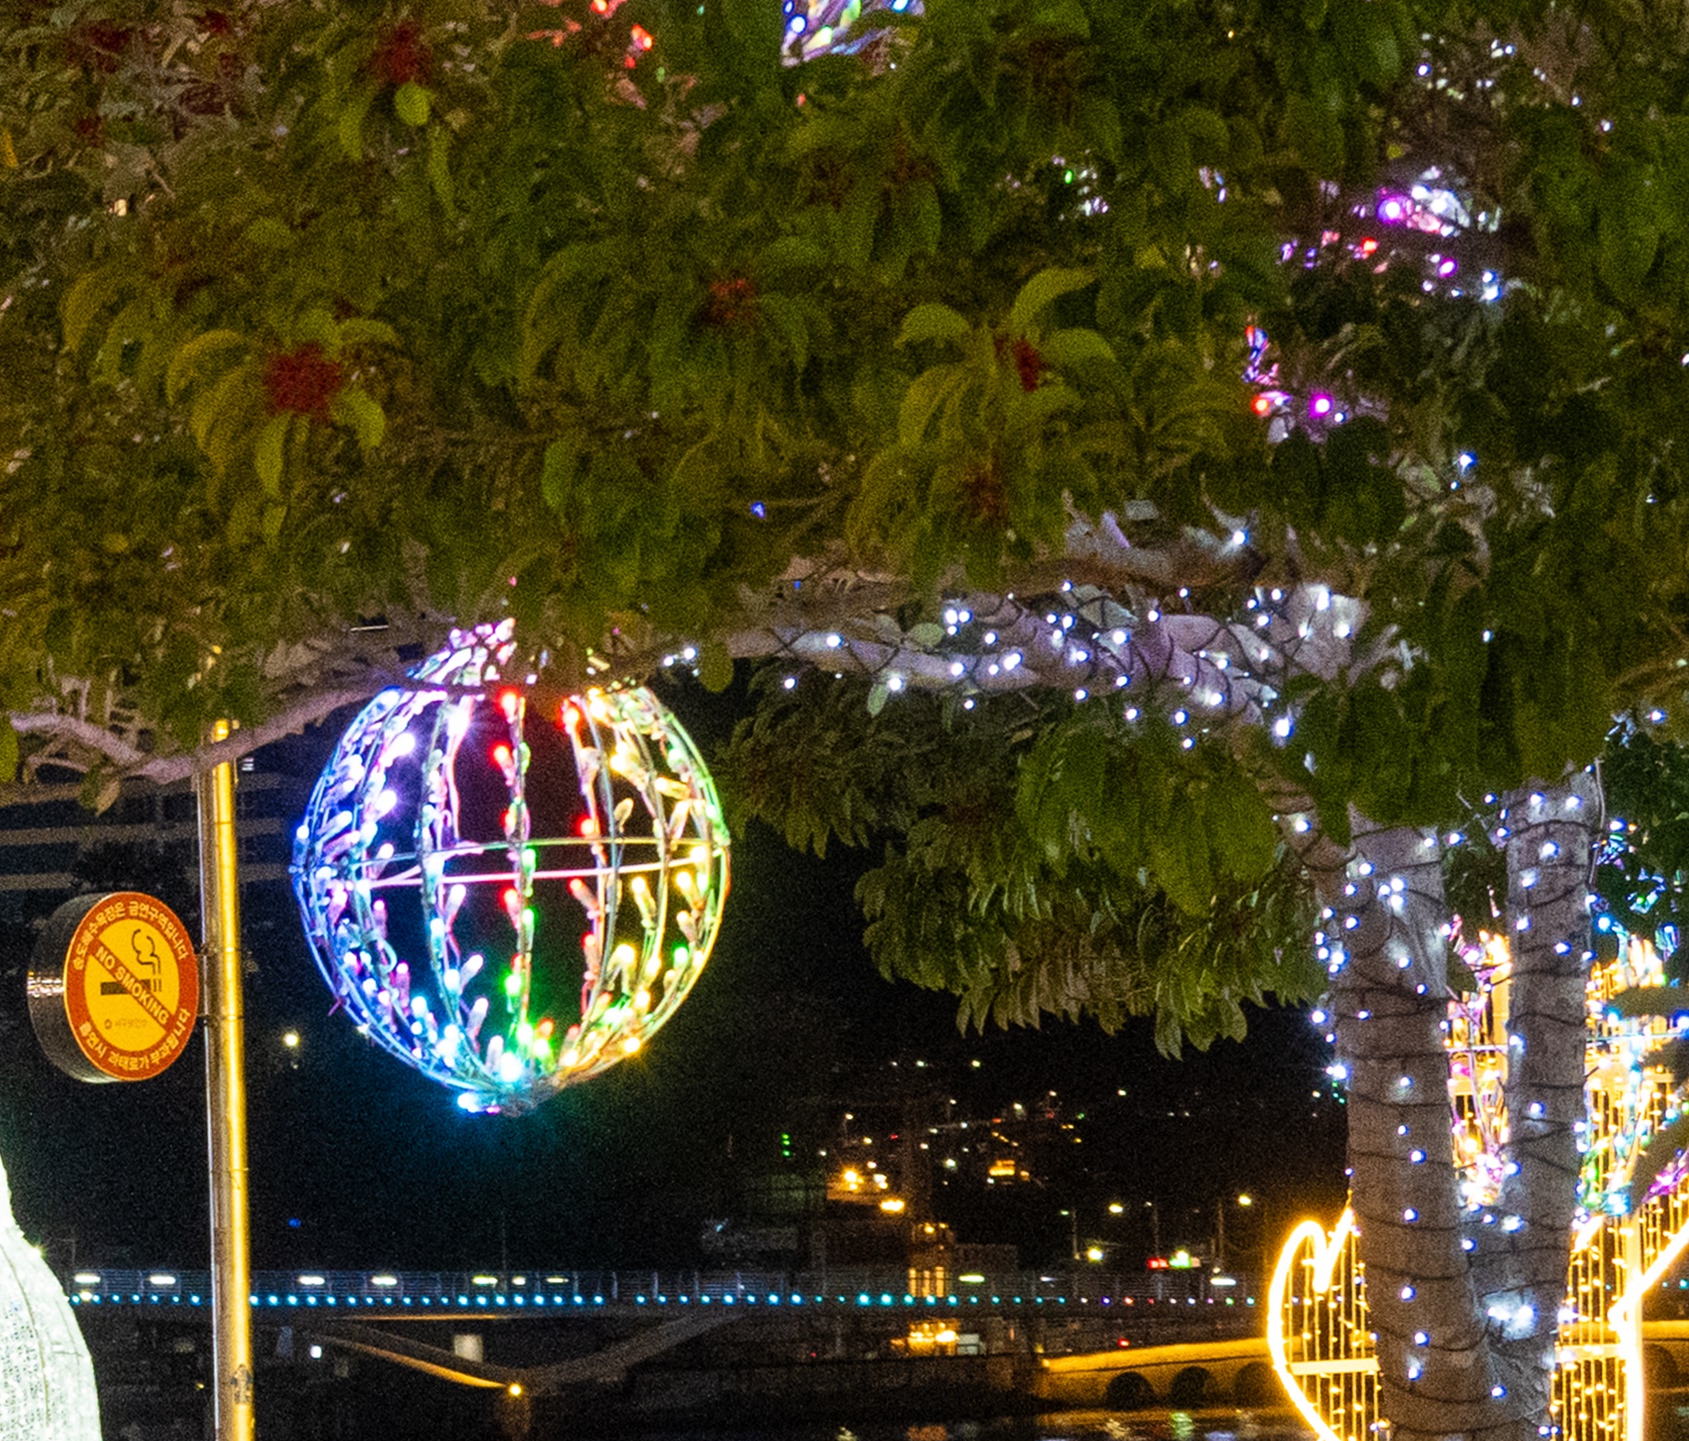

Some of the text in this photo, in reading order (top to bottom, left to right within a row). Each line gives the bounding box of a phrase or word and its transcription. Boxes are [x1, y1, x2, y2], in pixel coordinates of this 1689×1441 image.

[128, 900, 189, 960] 금연구역입니다
[96, 946, 169, 1025] NO SMOKING
